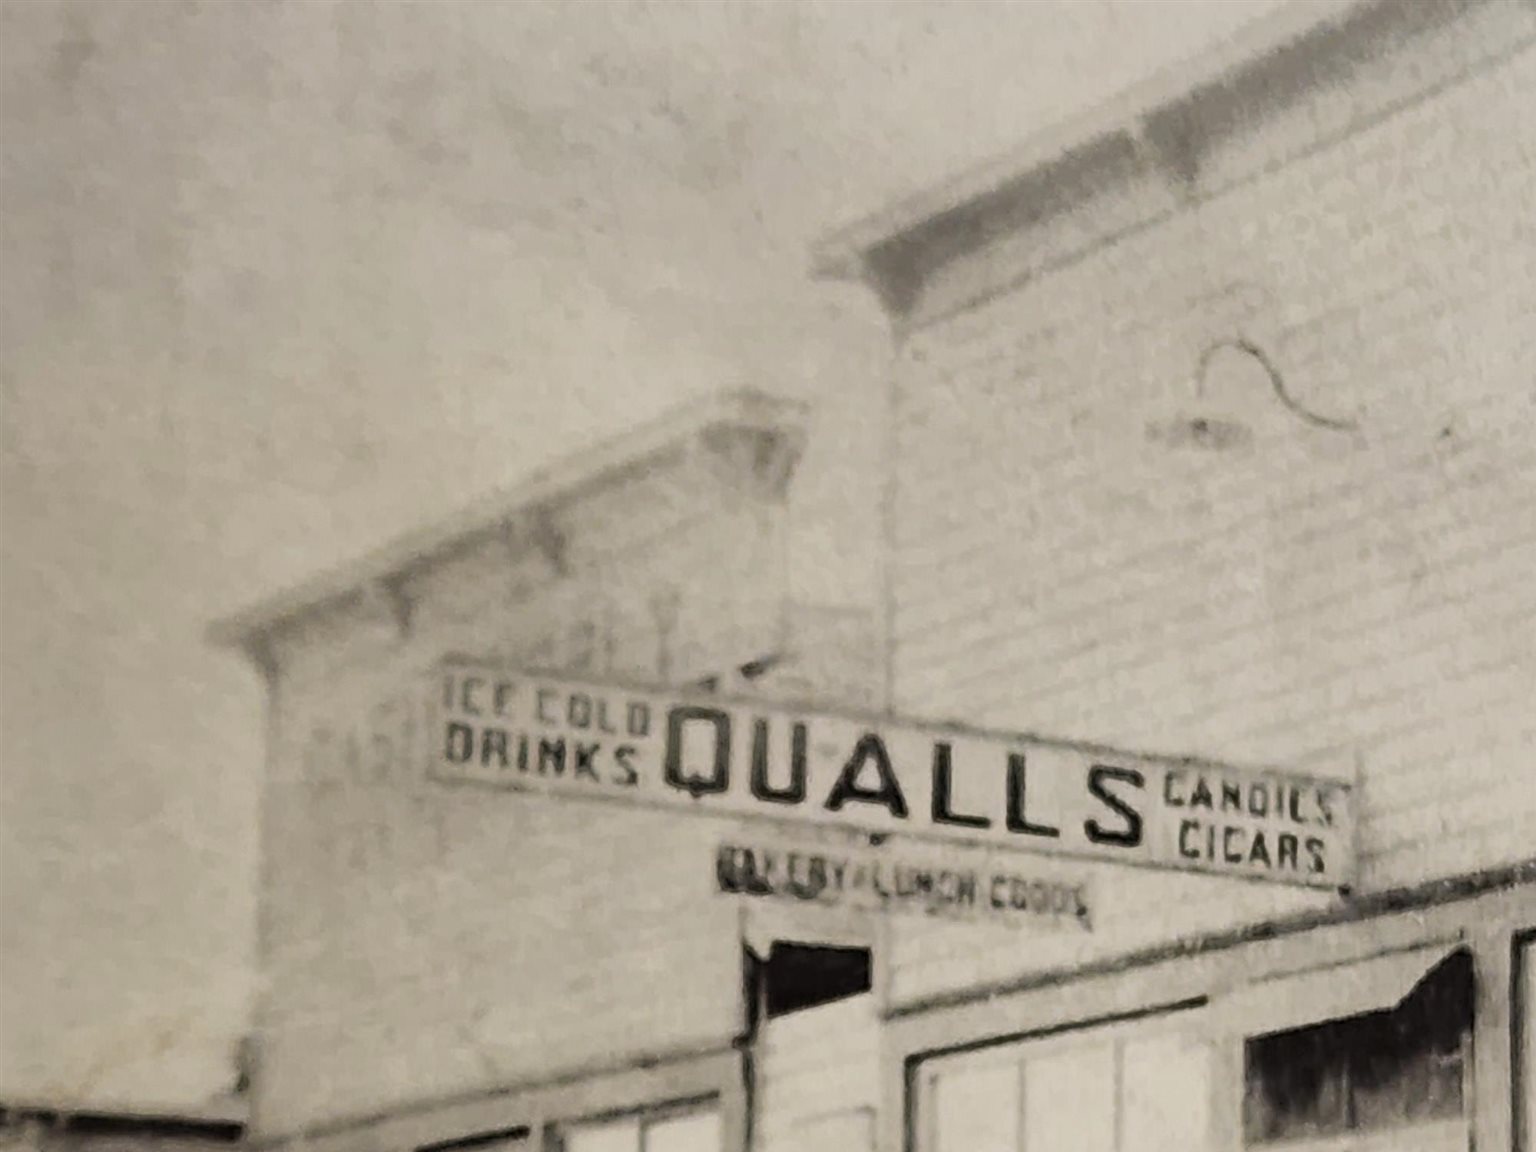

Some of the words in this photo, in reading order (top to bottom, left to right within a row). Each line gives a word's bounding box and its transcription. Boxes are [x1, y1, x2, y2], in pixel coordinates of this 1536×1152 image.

[443, 674, 515, 719] ICE
[536, 686, 650, 737] COLD
[445, 720, 639, 787] DRINKS
[664, 705, 1146, 848] QUALLS
[1163, 769, 1335, 827] CANDIES
